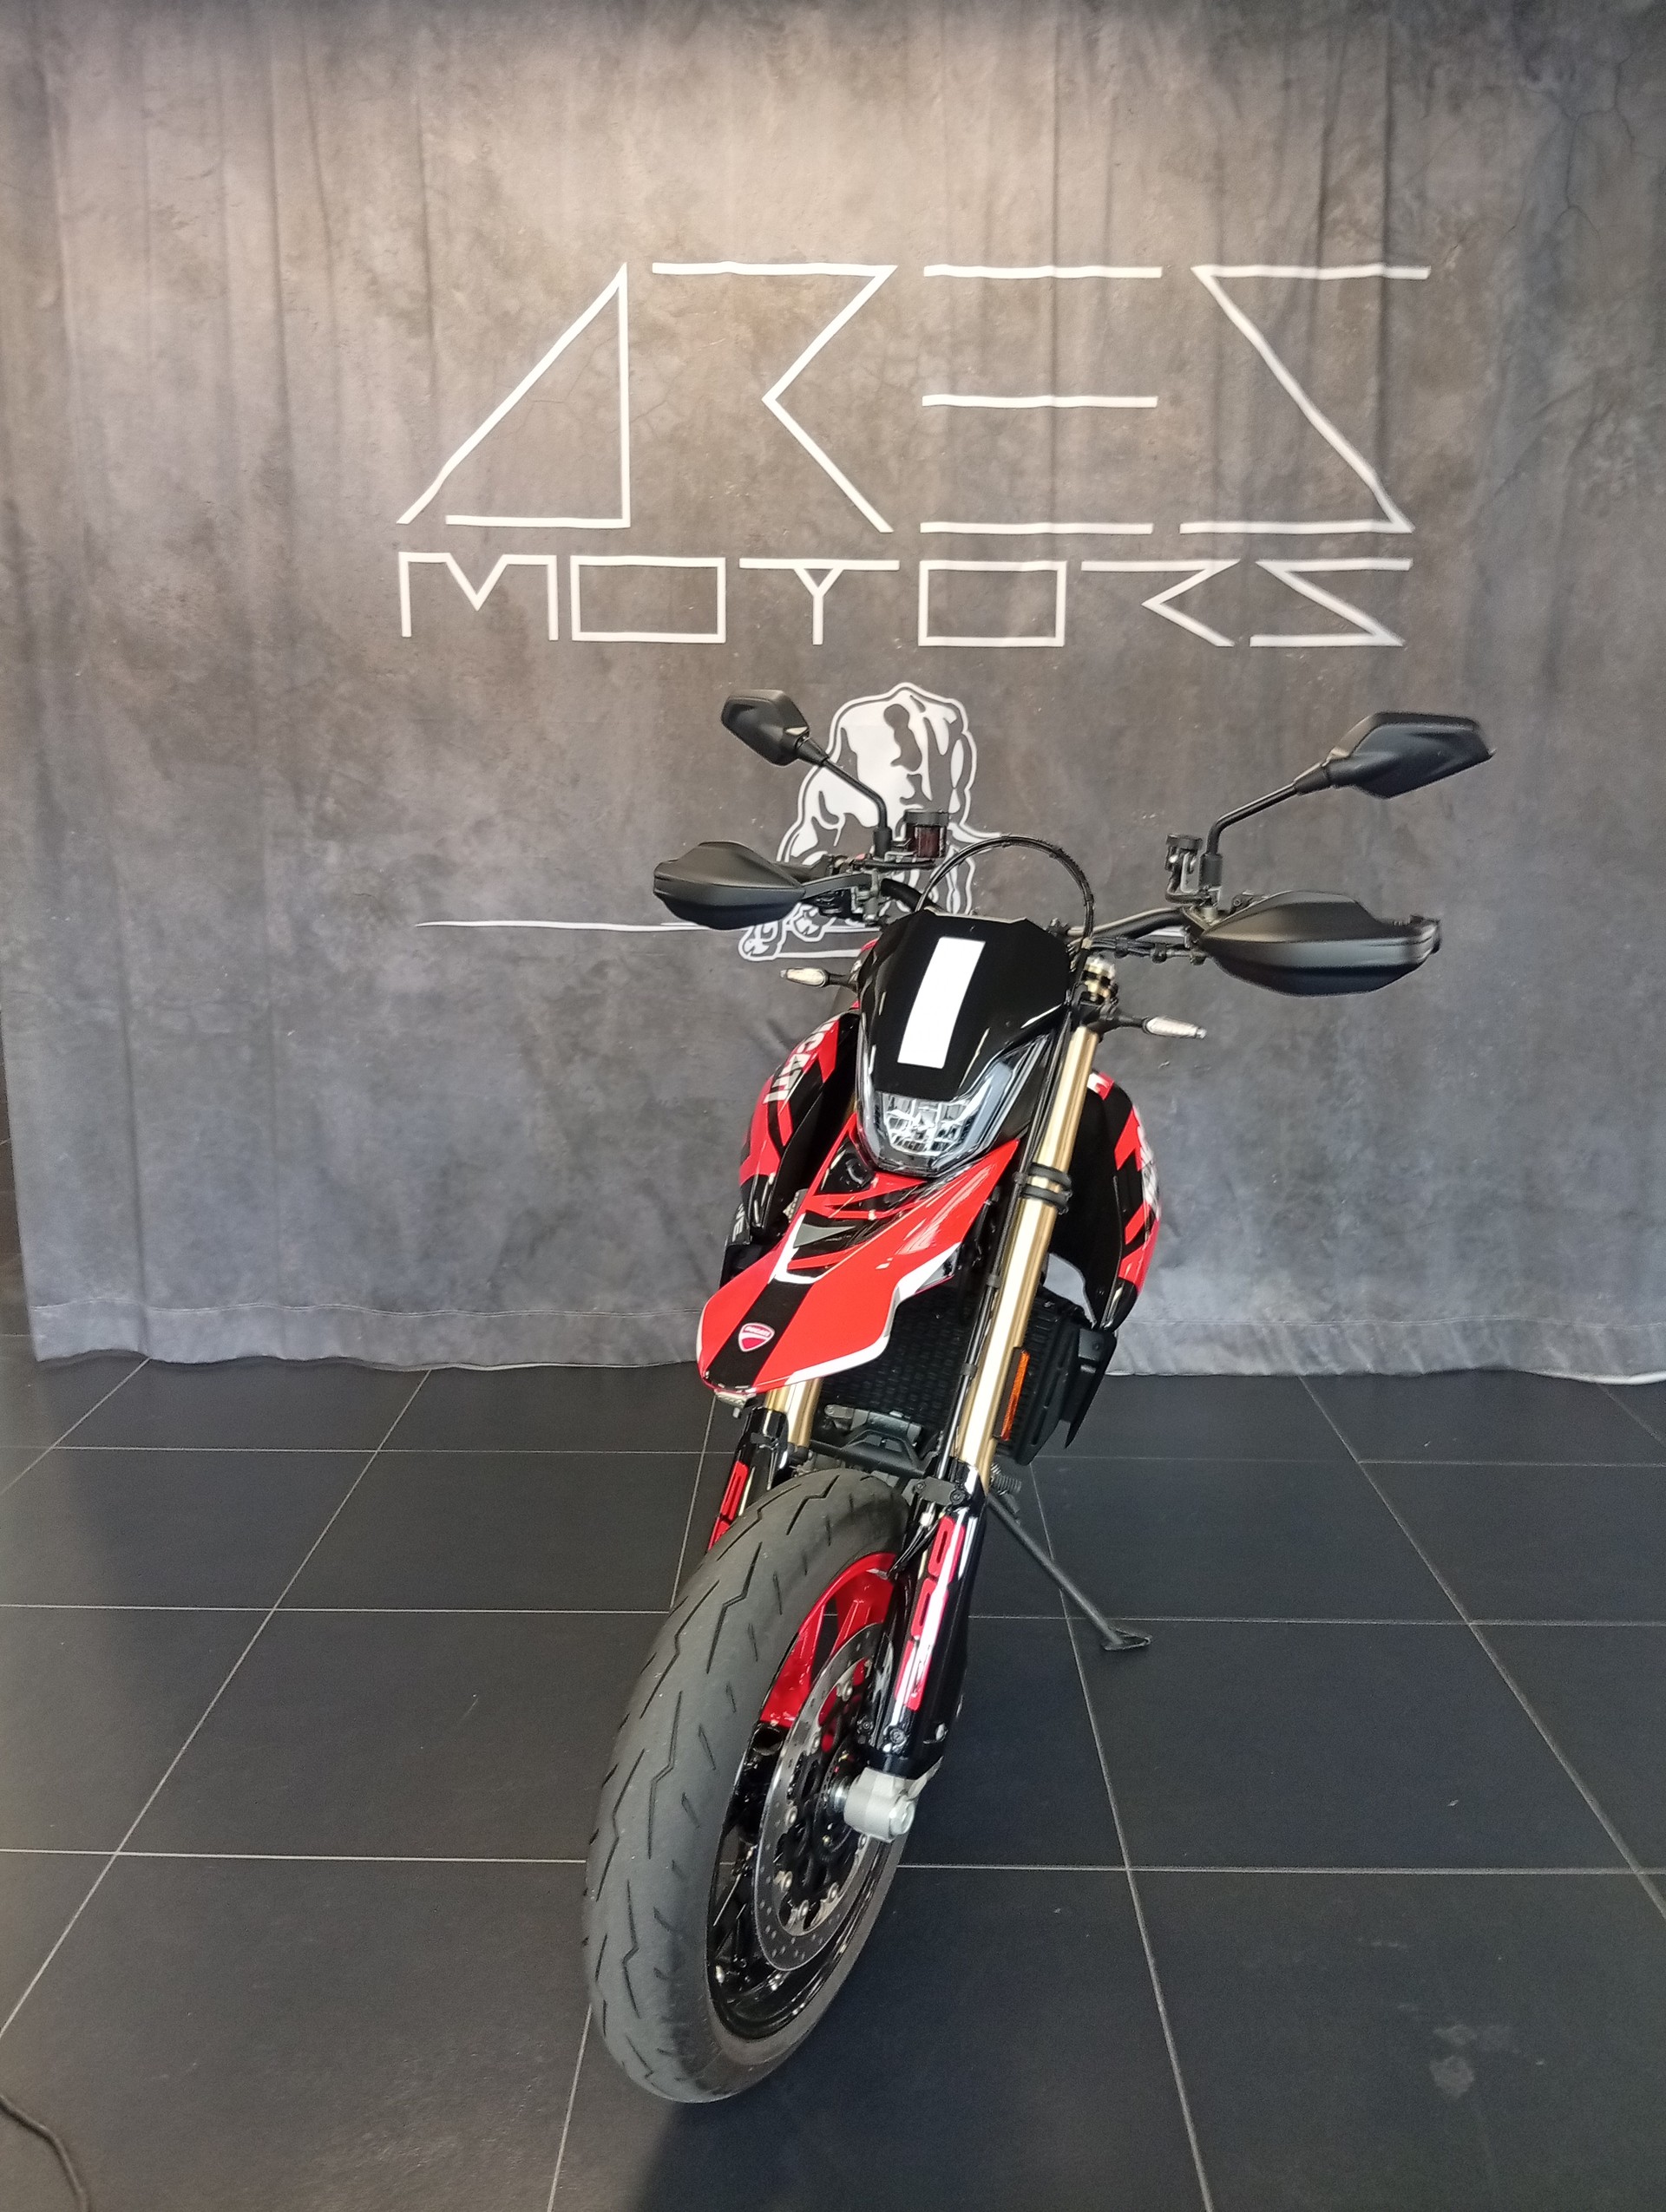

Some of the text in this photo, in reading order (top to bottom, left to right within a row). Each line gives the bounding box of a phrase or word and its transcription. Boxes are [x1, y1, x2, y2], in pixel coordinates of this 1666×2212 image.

[396, 262, 1430, 535] ARES
[398, 551, 1413, 648] MOTORS
[763, 1009, 841, 1104] UCATI
